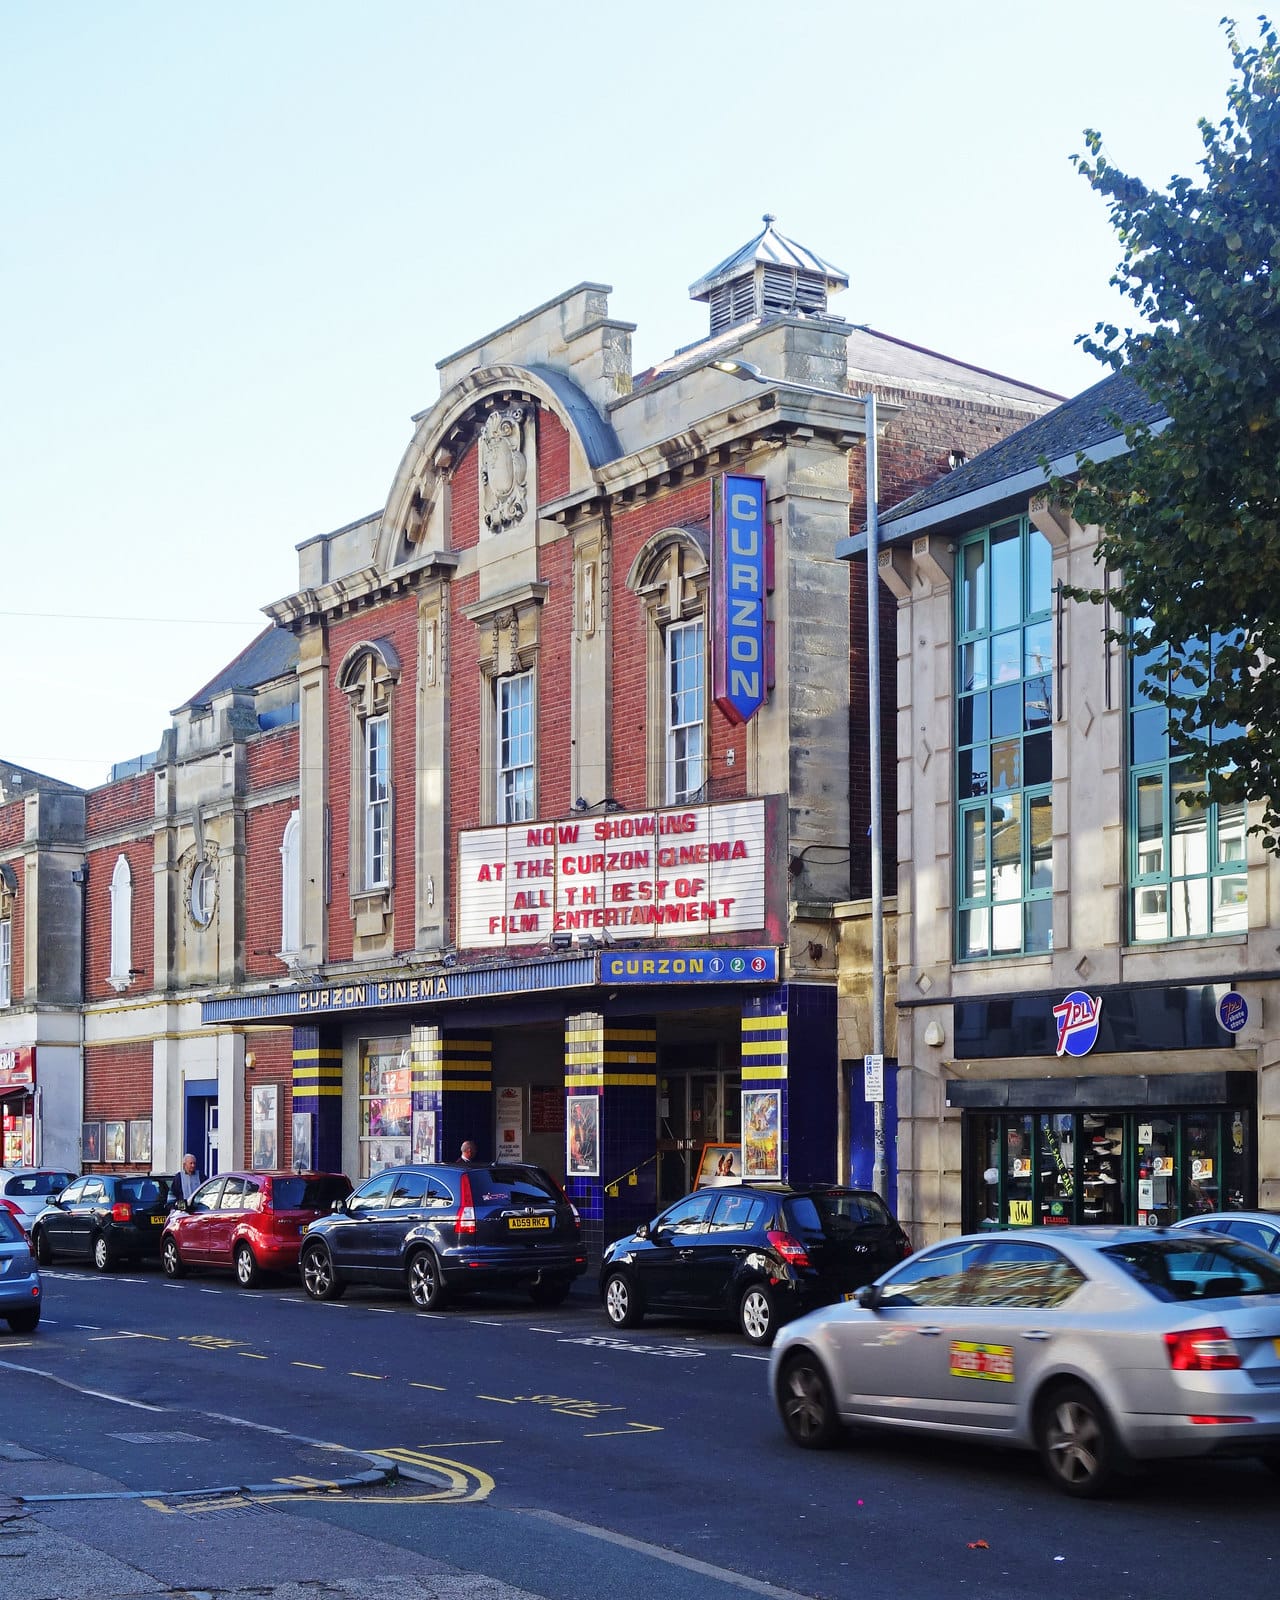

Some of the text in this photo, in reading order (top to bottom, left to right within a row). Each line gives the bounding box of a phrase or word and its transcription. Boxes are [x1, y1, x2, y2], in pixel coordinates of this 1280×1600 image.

[731, 494, 760, 699] CURZON
[527, 813, 696, 848] NOW SHOWING
[477, 839, 747, 882] AT THE CURZON CINEMA
[514, 889, 550, 909] ALL
[675, 878, 706, 898] OF
[489, 898, 736, 935] FILM ENTERTAINMENT
[611, 958, 704, 975] CURZON
[299, 977, 449, 1010] CURZON CINEMA
[1043, 1123, 1074, 1196] SALE SALE SALE
[1015, 1201, 1029, 1221] JM
[556, 1337, 706, 1358] DISABLED
